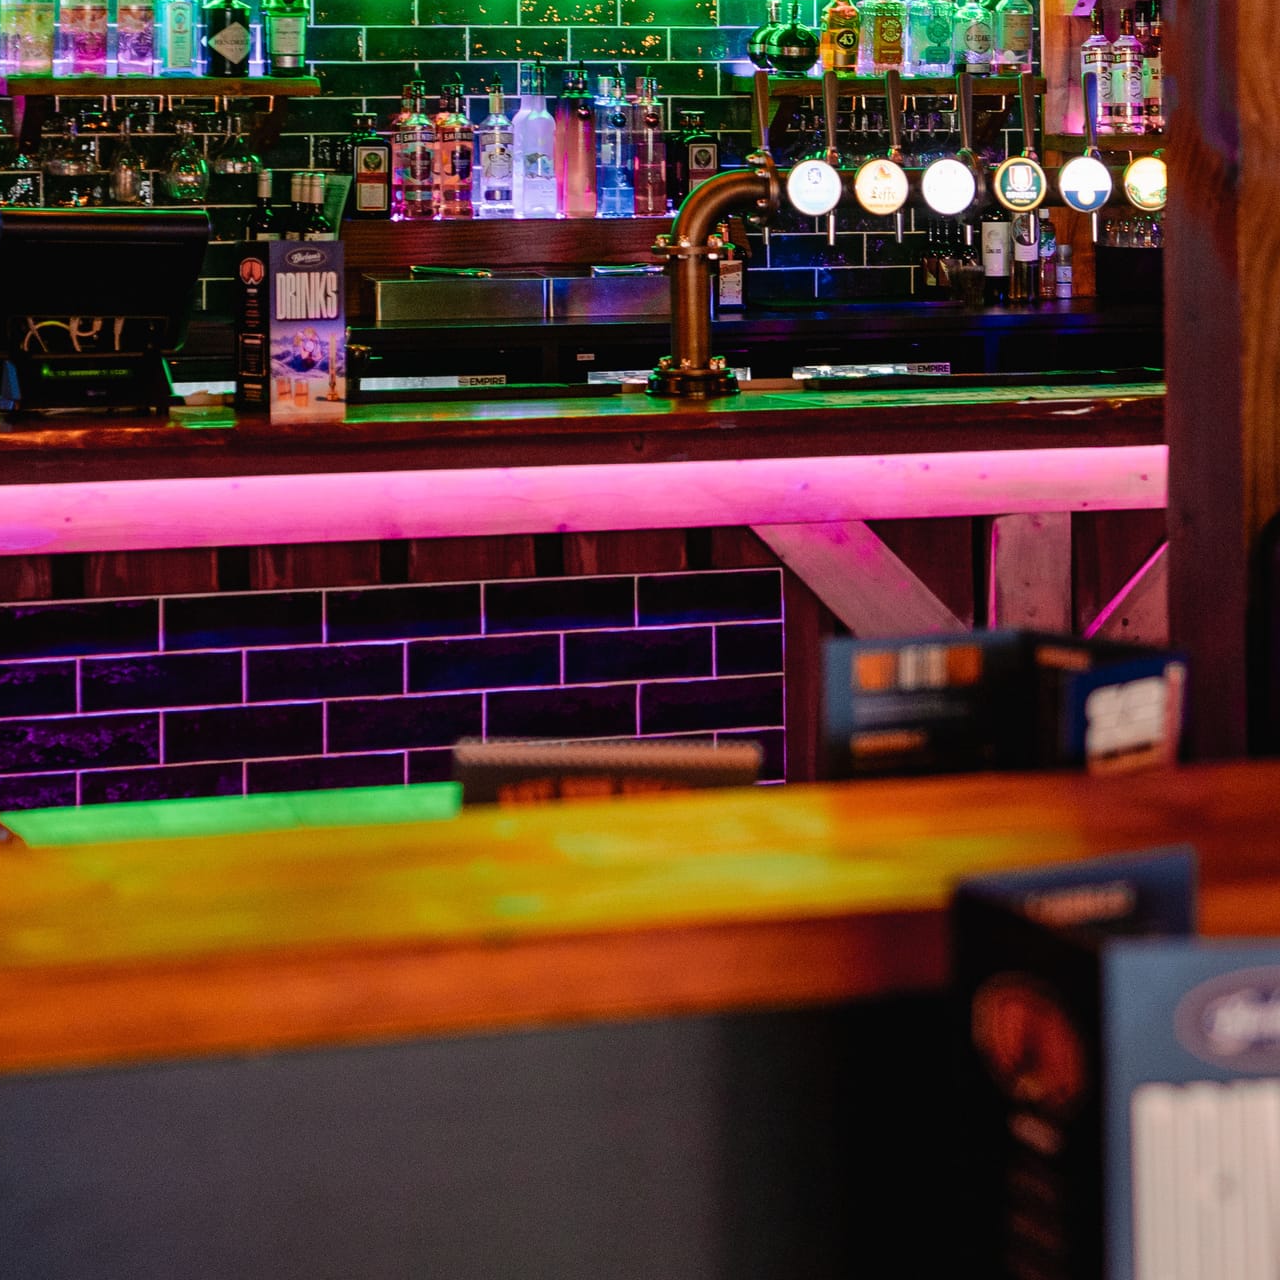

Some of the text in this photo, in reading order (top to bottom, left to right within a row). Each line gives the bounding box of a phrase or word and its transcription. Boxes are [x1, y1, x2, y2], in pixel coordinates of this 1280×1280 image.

[839, 32, 855, 45] 43
[275, 271, 339, 320] DRINKS
[917, 363, 950, 375] EMPIRE
[469, 376, 506, 386] EMPIRE
